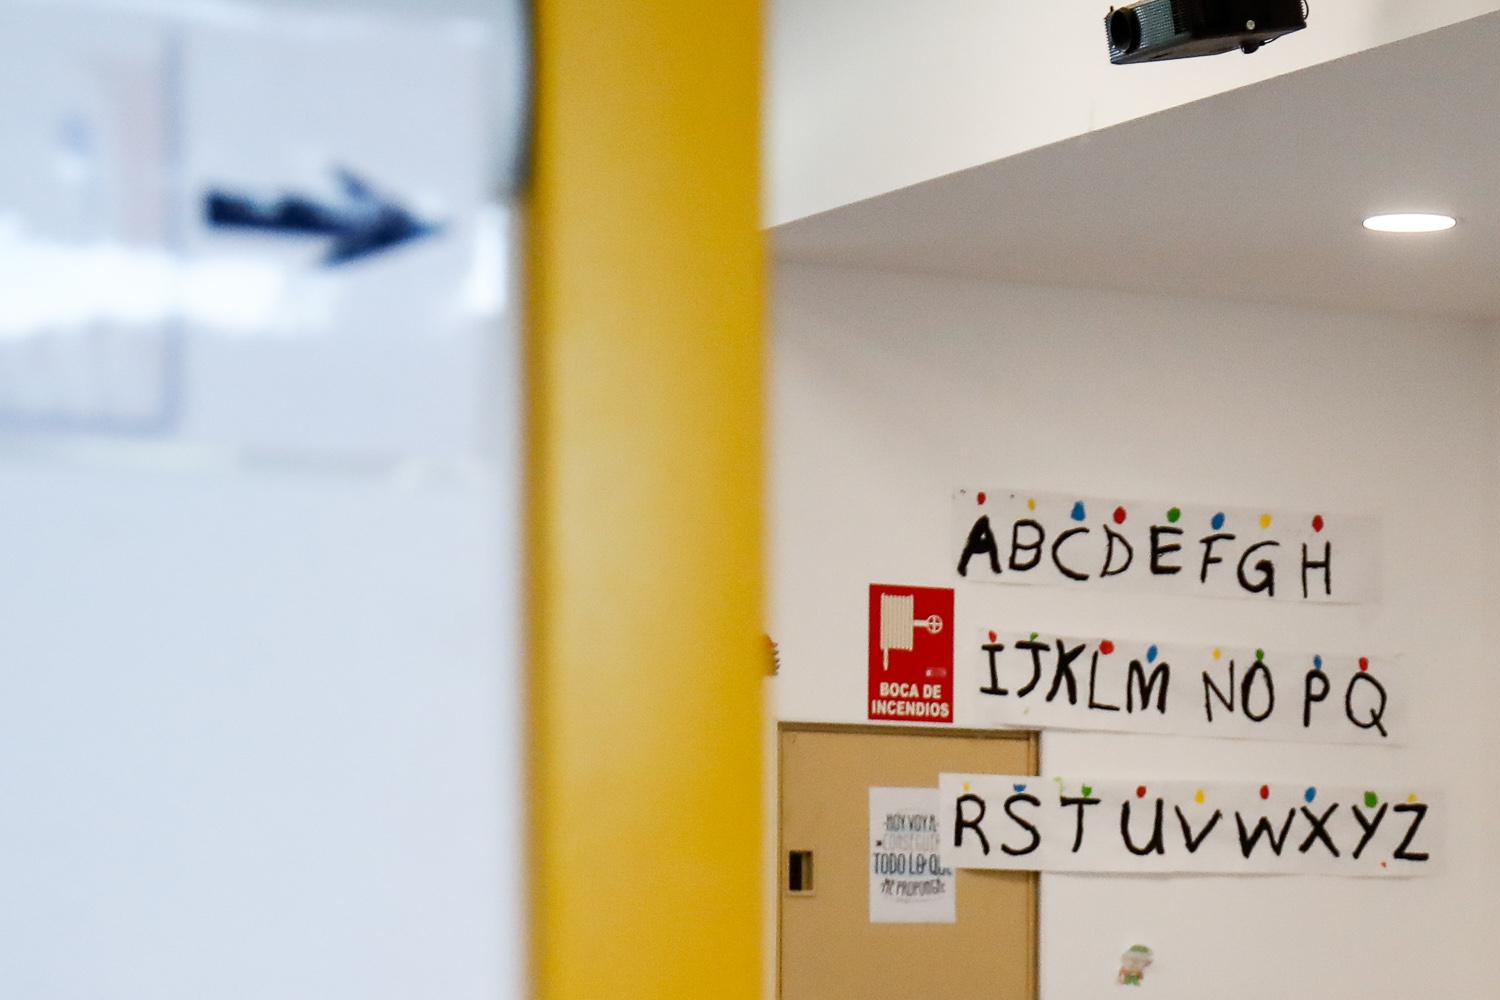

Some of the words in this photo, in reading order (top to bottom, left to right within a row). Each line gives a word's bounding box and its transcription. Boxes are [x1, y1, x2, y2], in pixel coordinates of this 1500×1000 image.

[880, 682, 919, 698] BOCA
[923, 683, 942, 699] DE
[872, 699, 950, 717] INCENDIOS
[873, 853, 906, 875] TODO
